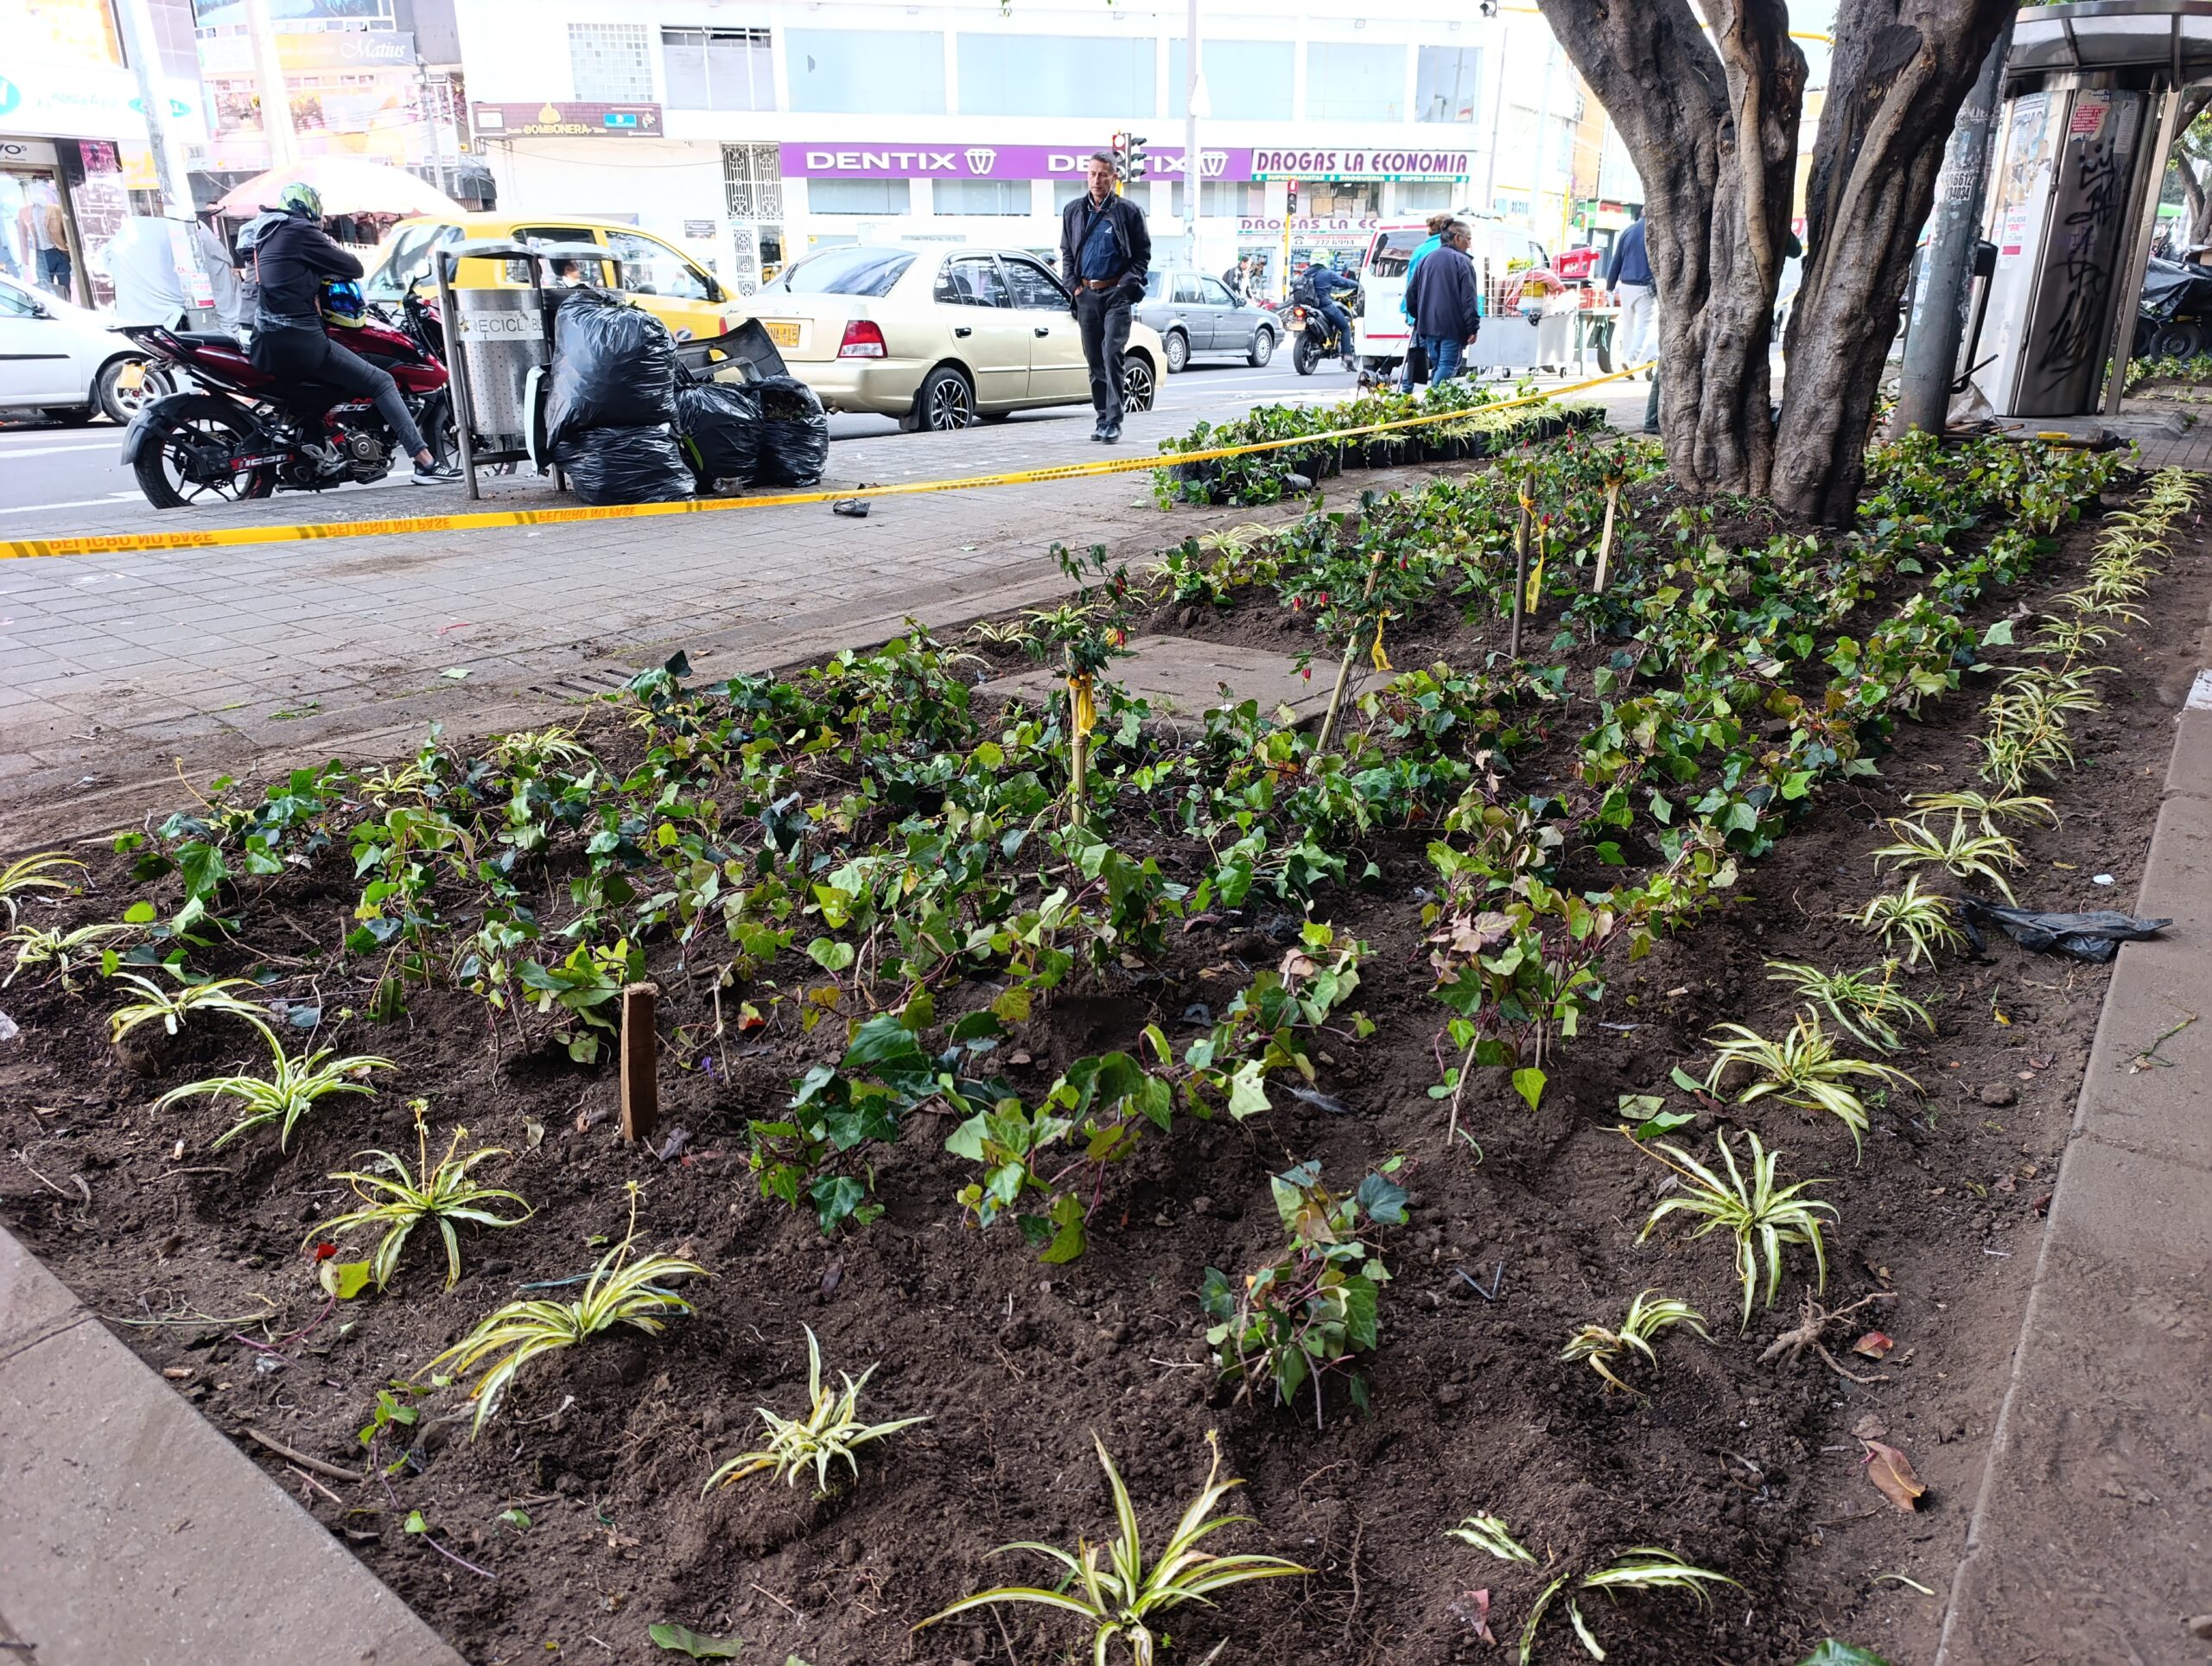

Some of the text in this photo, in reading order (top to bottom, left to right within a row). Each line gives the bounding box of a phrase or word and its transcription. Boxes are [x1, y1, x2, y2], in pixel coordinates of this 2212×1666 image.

[340, 37, 406, 59] Matius
[806, 151, 957, 171] DENTIX
[1047, 155, 1186, 173] DETIX
[1256, 152, 1468, 173] DROGAS LA ECONOMIA
[1242, 219, 1319, 230] DROGAS
[1330, 219, 1348, 230] LA
[328, 404, 373, 412] 200
